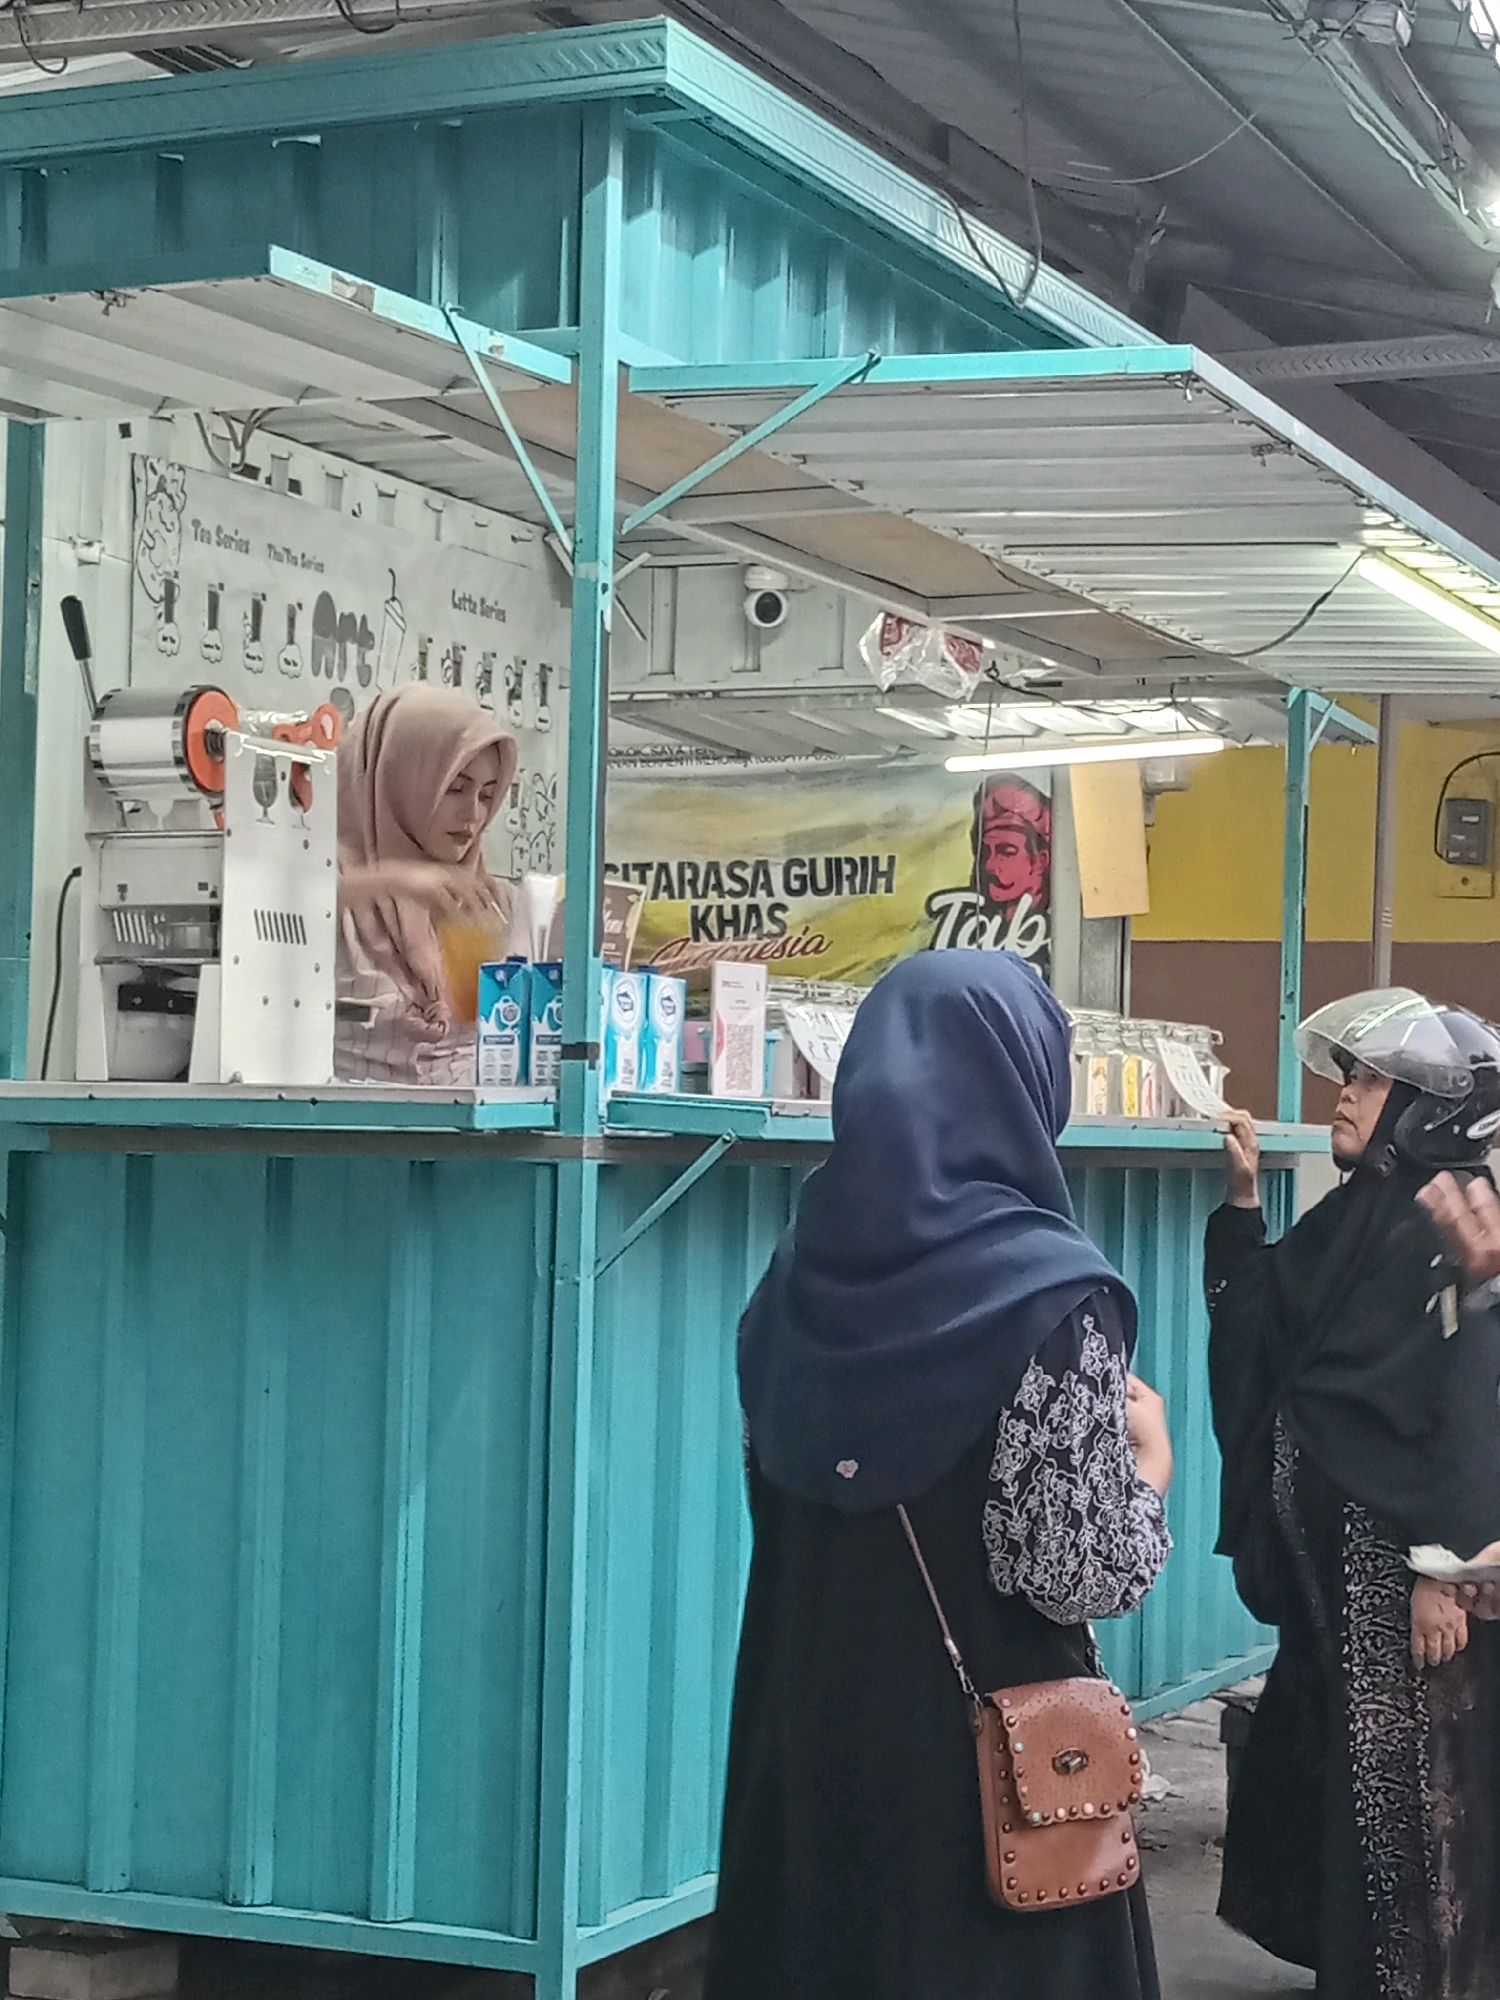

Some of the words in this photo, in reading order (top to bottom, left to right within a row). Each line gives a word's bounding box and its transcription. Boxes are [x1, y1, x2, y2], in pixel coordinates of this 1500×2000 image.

[191, 518, 212, 545] Tea
[215, 524, 250, 555] Series
[451, 588, 478, 615] Latte
[479, 596, 507, 624] Series
[311, 589, 376, 688] Art
[782, 855, 897, 897] GURIH
[689, 902, 791, 943] KHAS
[930, 891, 1053, 959] Tab
[649, 925, 834, 971] Indonesia
